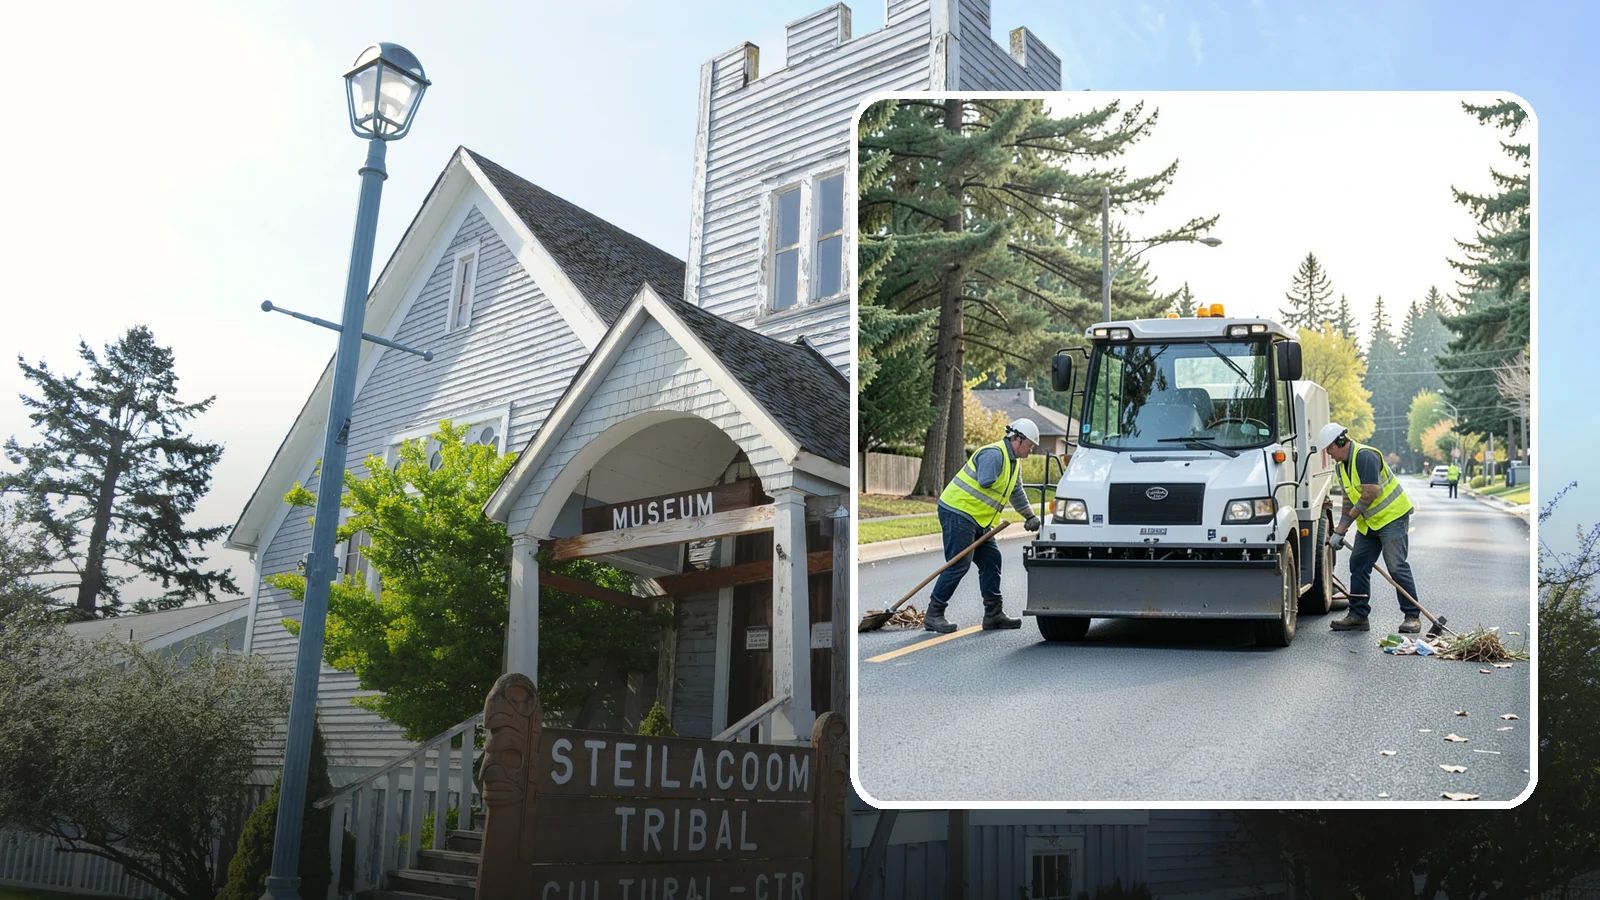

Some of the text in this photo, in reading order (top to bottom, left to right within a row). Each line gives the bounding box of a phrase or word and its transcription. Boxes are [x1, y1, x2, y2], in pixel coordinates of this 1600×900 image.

[613, 491, 713, 531] MUSEUM
[551, 738, 809, 792] STEILACOOM
[615, 806, 757, 852] TRIBAL
